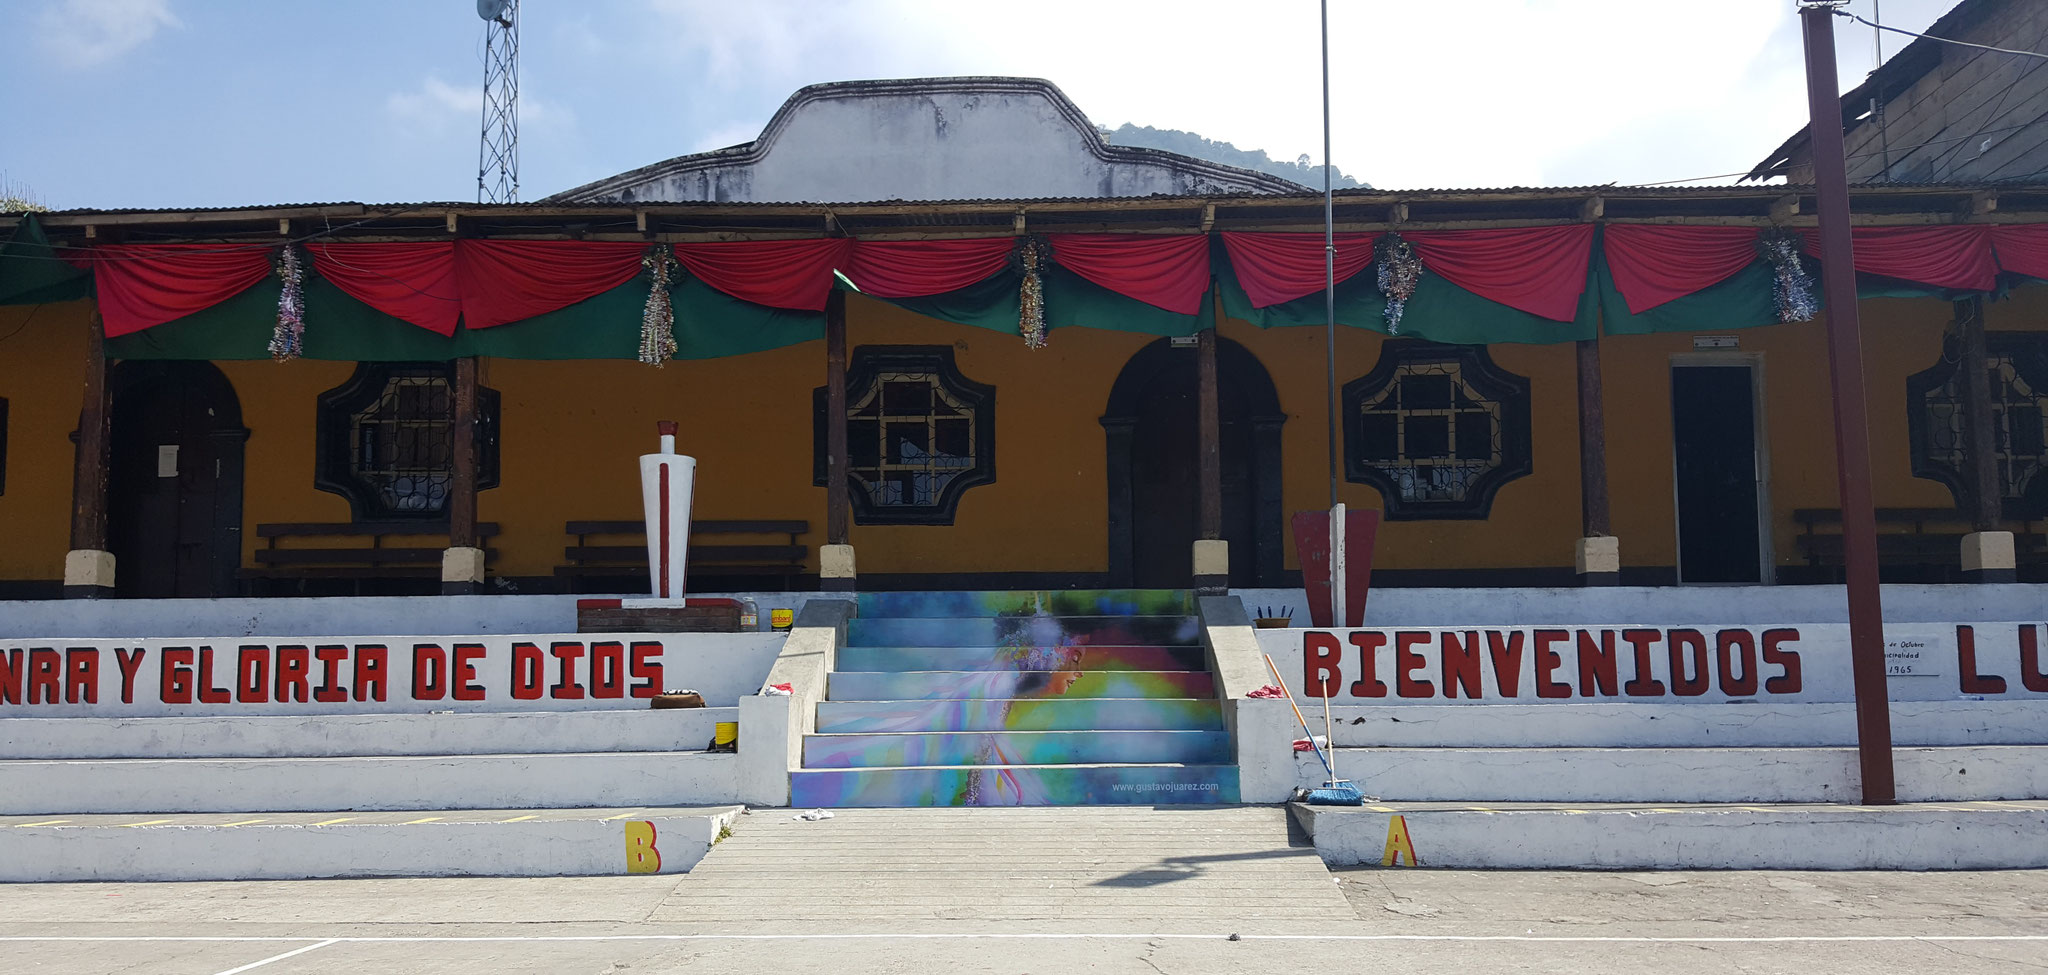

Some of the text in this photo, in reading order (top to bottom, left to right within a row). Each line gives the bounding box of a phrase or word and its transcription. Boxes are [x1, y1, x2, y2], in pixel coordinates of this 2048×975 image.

[114, 647, 146, 704] Y
[160, 644, 388, 704] GLORIA
[411, 642, 487, 702] DE
[510, 640, 664, 700] DIOS
[1303, 628, 1802, 698] BIENVENIDOS
[1889, 665, 1912, 674] 1965
[1112, 781, 1219, 793] www.gustavojuarez.com
[625, 820, 661, 874] B
[1381, 815, 1417, 867] A
